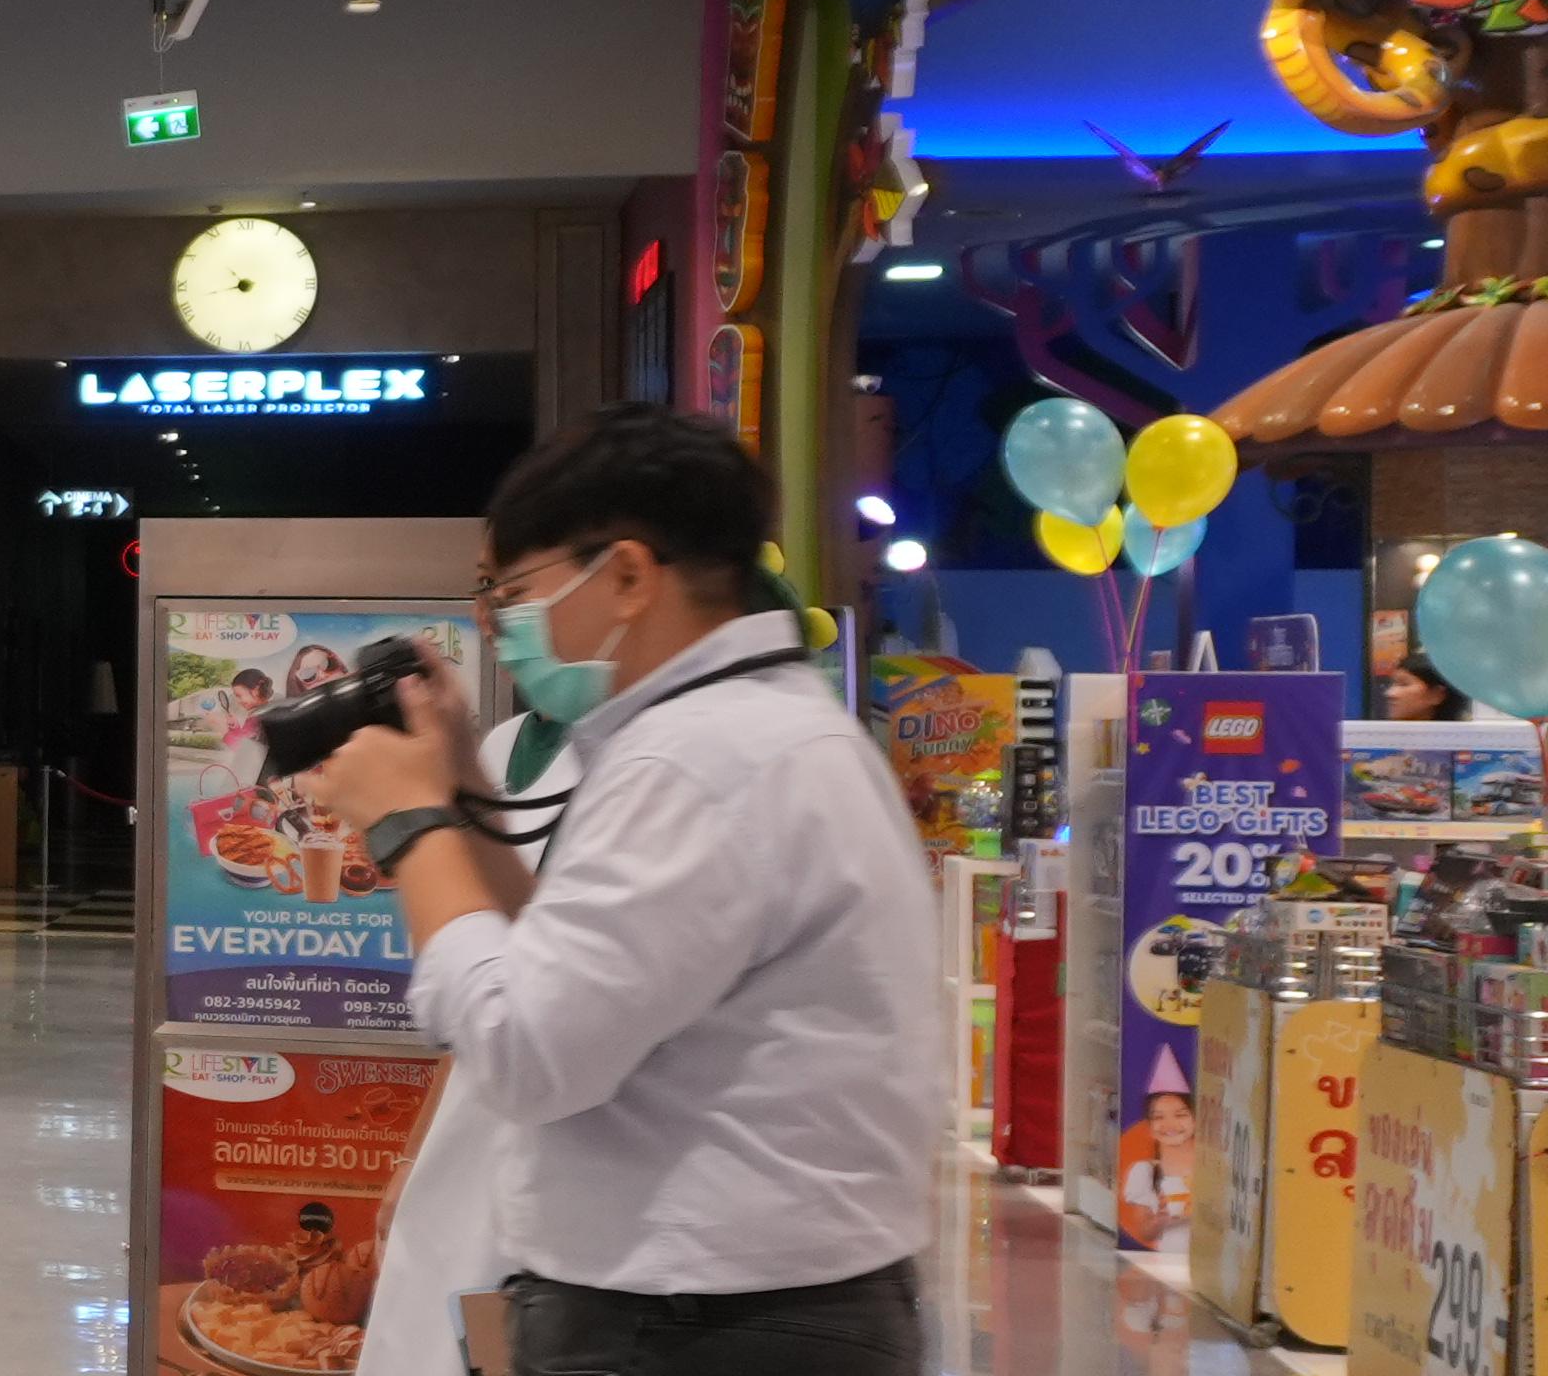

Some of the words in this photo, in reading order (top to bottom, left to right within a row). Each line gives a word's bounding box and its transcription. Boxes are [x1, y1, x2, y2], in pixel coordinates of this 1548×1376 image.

[80, 368, 425, 404] LASERPLEX
[141, 403, 194, 414] TOTAL
[203, 403, 258, 414] LASER
[266, 402, 370, 414] PROJECTOR
[63, 490, 113, 503] CINEMA
[196, 613, 280, 630] LIFESTYLE
[220, 632, 249, 640] SHOP
[255, 632, 279, 640] PLAY
[897, 710, 982, 741] DINO
[1208, 719, 1258, 737] LEGO
[1194, 782, 1273, 806] BEST
[244, 911, 290, 925] YOUR
[296, 912, 351, 926] PLACE
[357, 914, 393, 927] FOR
[173, 925, 369, 957] EVERYDAY
[382, 932, 413, 960] LI
[246, 972, 340, 993] สนใจพื้นที่เช่า
[345, 979, 390, 995] ติดต่อ
[204, 996, 301, 1010] 082-3945942
[190, 1054, 277, 1074] LIFESTYLE
[316, 1059, 436, 1094] SWENSEN
[192, 1073, 211, 1081] EAT
[217, 1074, 246, 1083] SHOP
[252, 1075, 276, 1085] PLAY
[215, 1137, 316, 1167] ลดพิเศษ
[322, 1145, 356, 1170] 30
